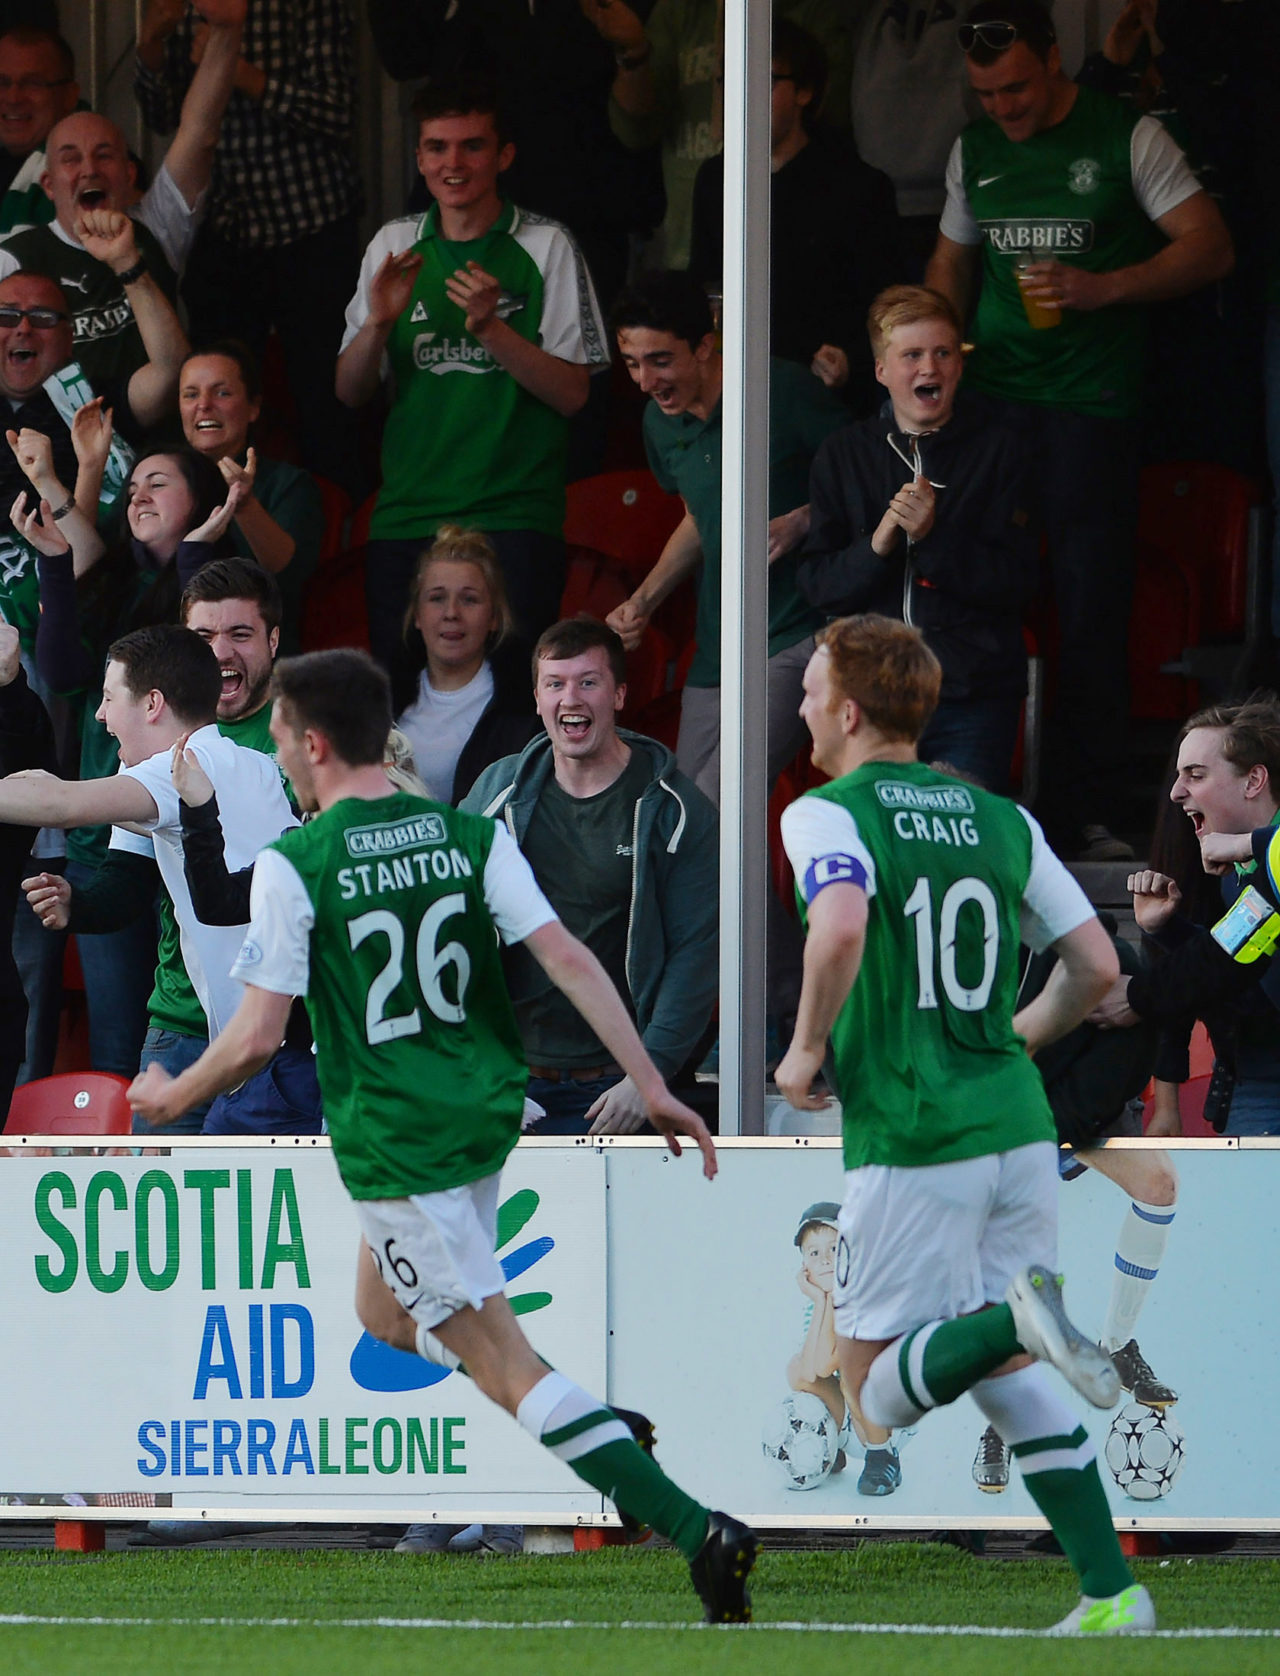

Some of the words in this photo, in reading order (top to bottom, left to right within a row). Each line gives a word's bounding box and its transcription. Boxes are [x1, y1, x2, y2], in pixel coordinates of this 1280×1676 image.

[981, 225, 1085, 251] RABBIE'S
[349, 817, 442, 853] CRABBIE'S
[894, 811, 980, 847] CRAIG
[337, 848, 473, 900] STANTON
[814, 853, 853, 885] C
[347, 892, 472, 1046] 26
[903, 876, 1001, 1012] 10
[34, 1168, 312, 1294] SCOTIA
[193, 1303, 316, 1400] AID
